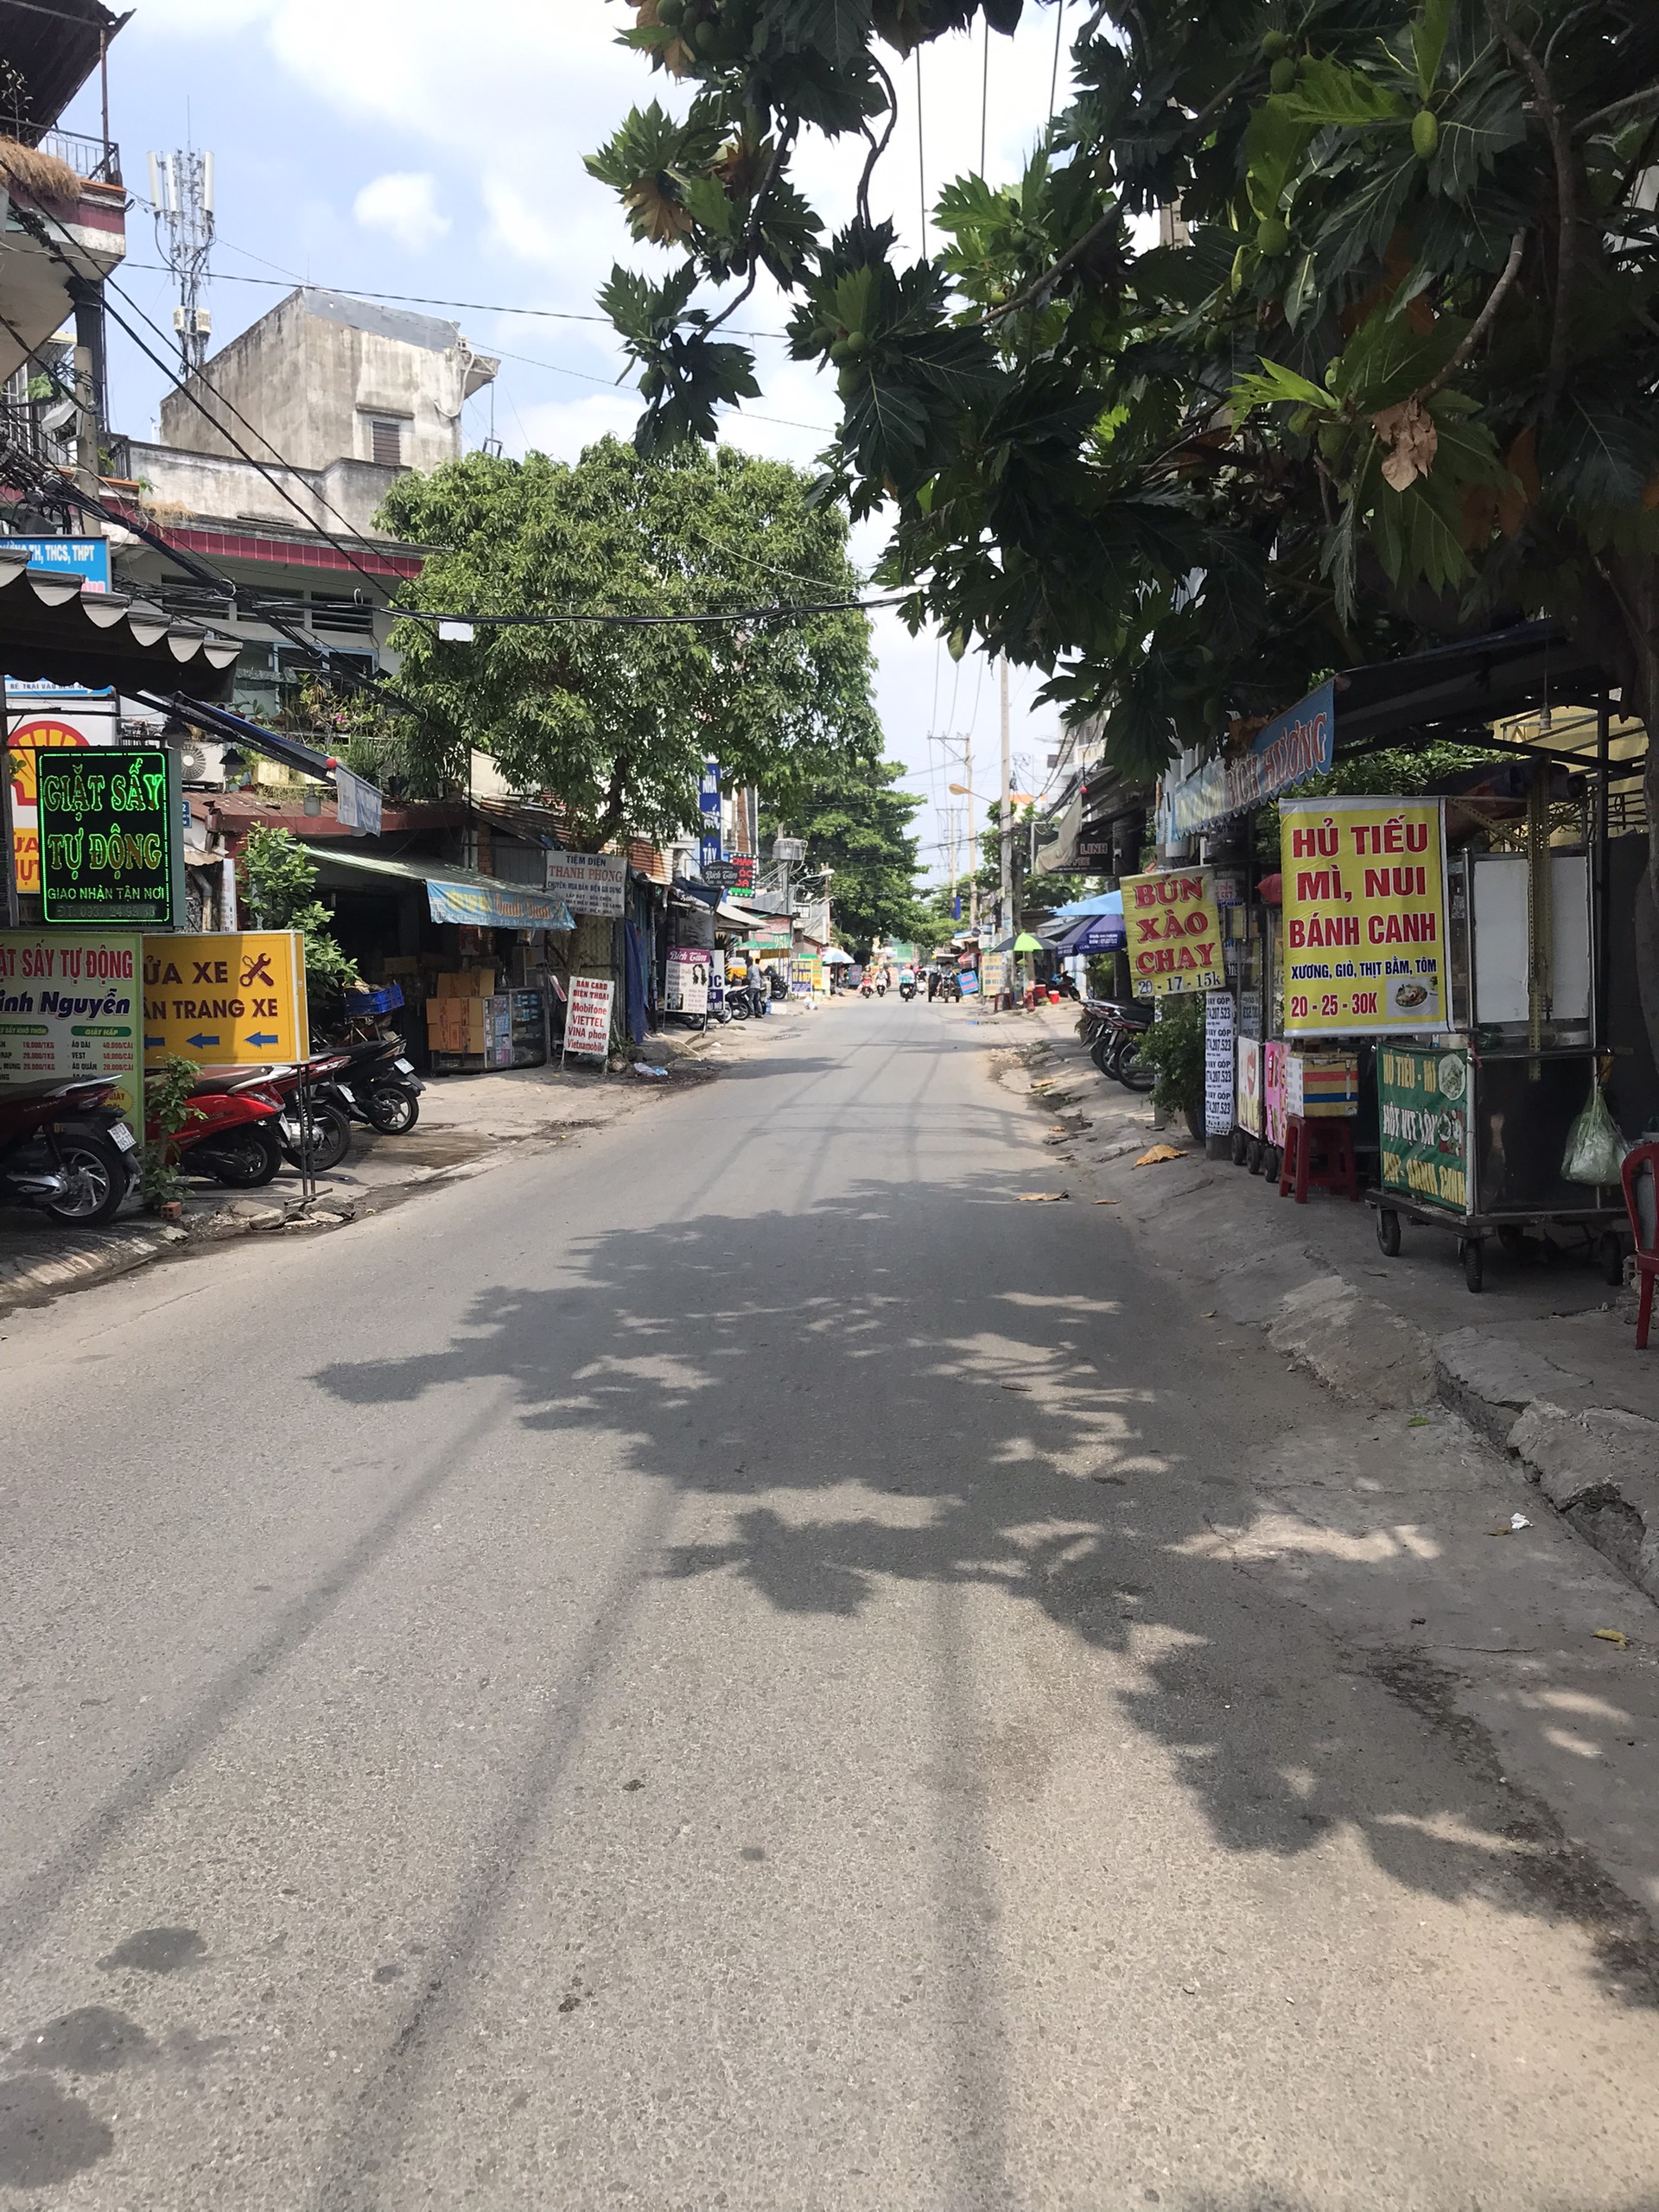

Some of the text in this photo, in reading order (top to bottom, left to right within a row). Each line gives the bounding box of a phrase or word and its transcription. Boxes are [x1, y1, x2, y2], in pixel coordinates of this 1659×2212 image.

[45, 543, 71, 564] THCS,
[72, 544, 95, 562] THPT
[1262, 711, 1328, 793] HƯƠNG
[44, 757, 163, 822] GIẶT SẤY
[1293, 814, 1428, 858] HỦ TIẾU
[48, 827, 84, 880] TỰ
[89, 823, 162, 880] ĐỘNG
[1080, 843, 1108, 855] LINH
[566, 855, 606, 868] TIỆM ĐIỆN
[549, 865, 623, 883] THANH PHONG
[1297, 864, 1427, 903] MÌ, NUI
[48, 887, 76, 899] GIAO
[116, 885, 140, 902] TẬN
[144, 885, 164, 899] NƠI
[1134, 874, 1204, 910] BÚN
[1136, 909, 1209, 944] XÀO
[1289, 912, 1436, 949] BÁNH CANH
[22, 939, 54, 978] SẤY
[60, 947, 82, 984] TỰ
[86, 944, 132, 984] ĐỘNG
[1136, 943, 1216, 975] CHAY
[1291, 963, 1332, 980] XƯƠNG,
[1335, 960, 1357, 978] GIÒ,
[1359, 962, 1382, 979] THỊT
[1415, 957, 1437, 974] TÔM
[193, 962, 228, 984] XE
[1138, 980, 1153, 995] 20
[1167, 976, 1184, 991] 17
[1197, 971, 1222, 988] 15k
[591, 982, 608, 990] CARD
[40, 988, 130, 1020] Nguyễn
[173, 998, 245, 1020] TRANG
[251, 998, 278, 1018] XE
[572, 1002, 607, 1015] Mobifone
[1290, 995, 1307, 1018] 20
[1321, 995, 1338, 1016] 25
[1351, 992, 1378, 1015] 30K
[568, 1026, 607, 1040] VINA phon
[572, 1015, 604, 1028] VIETTEL
[568, 1039, 605, 1052] Vietnamobile
